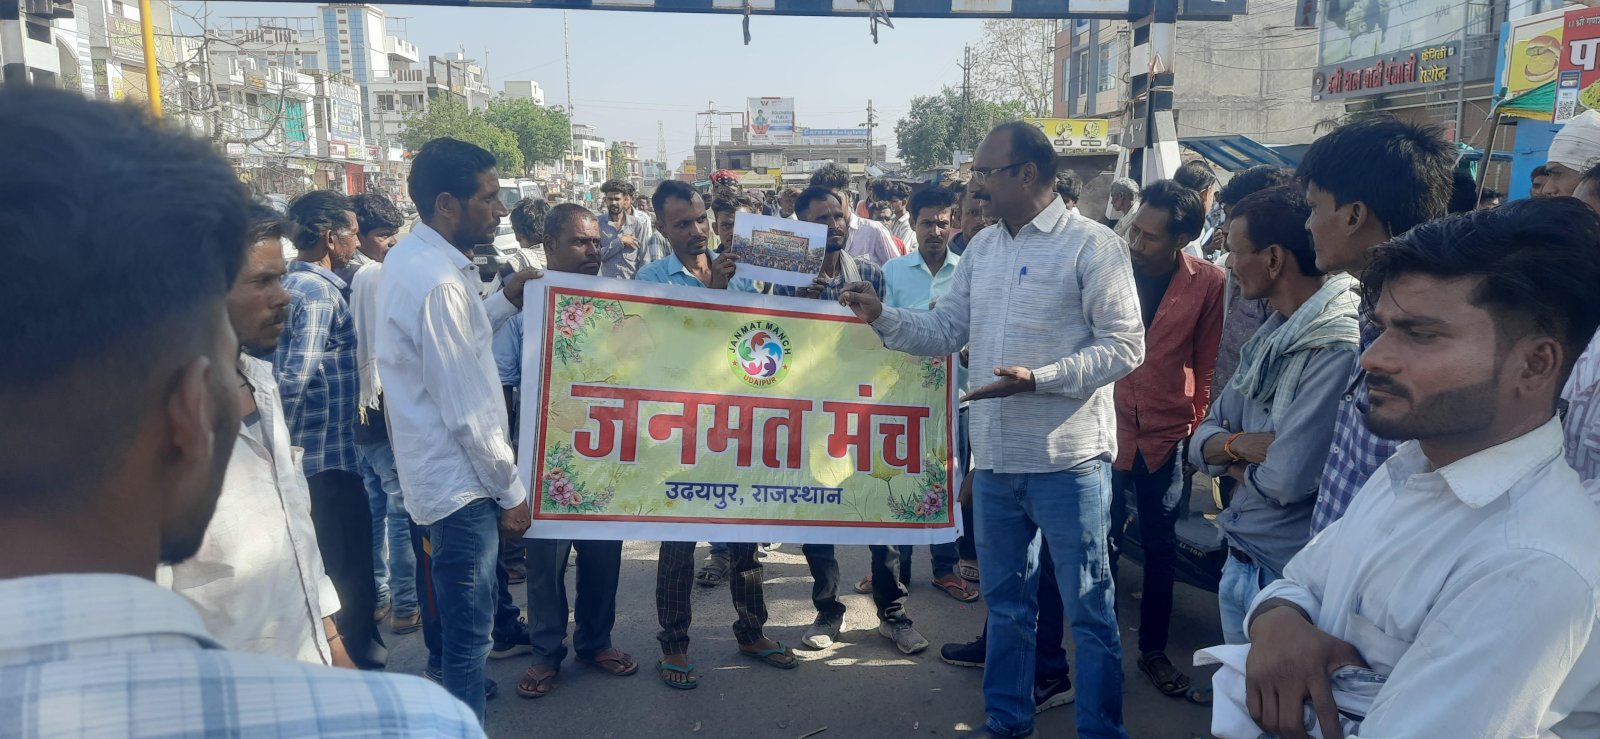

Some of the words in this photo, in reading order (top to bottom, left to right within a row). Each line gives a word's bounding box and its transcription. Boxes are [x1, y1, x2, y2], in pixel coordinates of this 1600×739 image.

[1385, 53, 1418, 84] पंजाबी
[729, 321, 762, 353] JANMAT
[765, 322, 791, 354] MANCH
[743, 375, 777, 386] UDAIPUR
[569, 384, 813, 469] जनमत
[823, 384, 929, 474] मंच
[664, 480, 743, 509] उदयपुर,
[752, 482, 844, 505] राजस्थान
